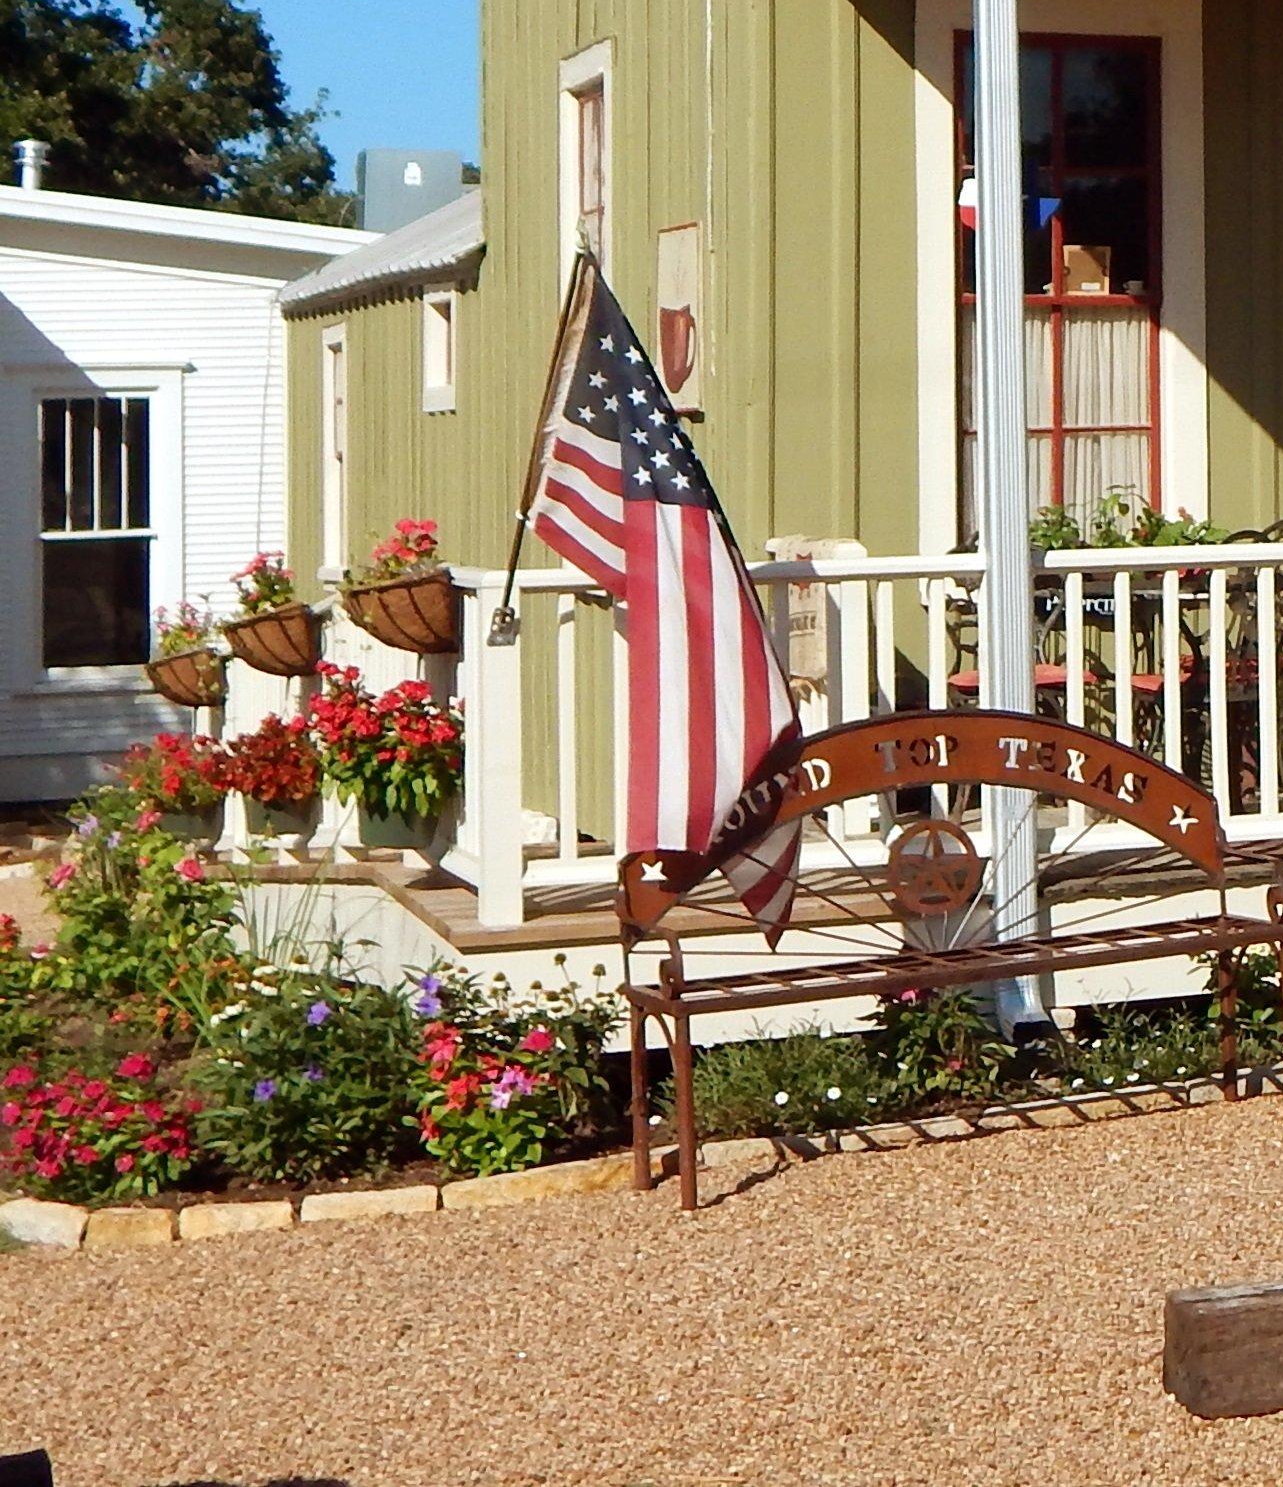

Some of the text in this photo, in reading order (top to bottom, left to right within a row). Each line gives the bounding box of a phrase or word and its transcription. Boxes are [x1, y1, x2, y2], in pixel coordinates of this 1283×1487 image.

[712, 735, 1148, 845] OUND TOP TEXAS
